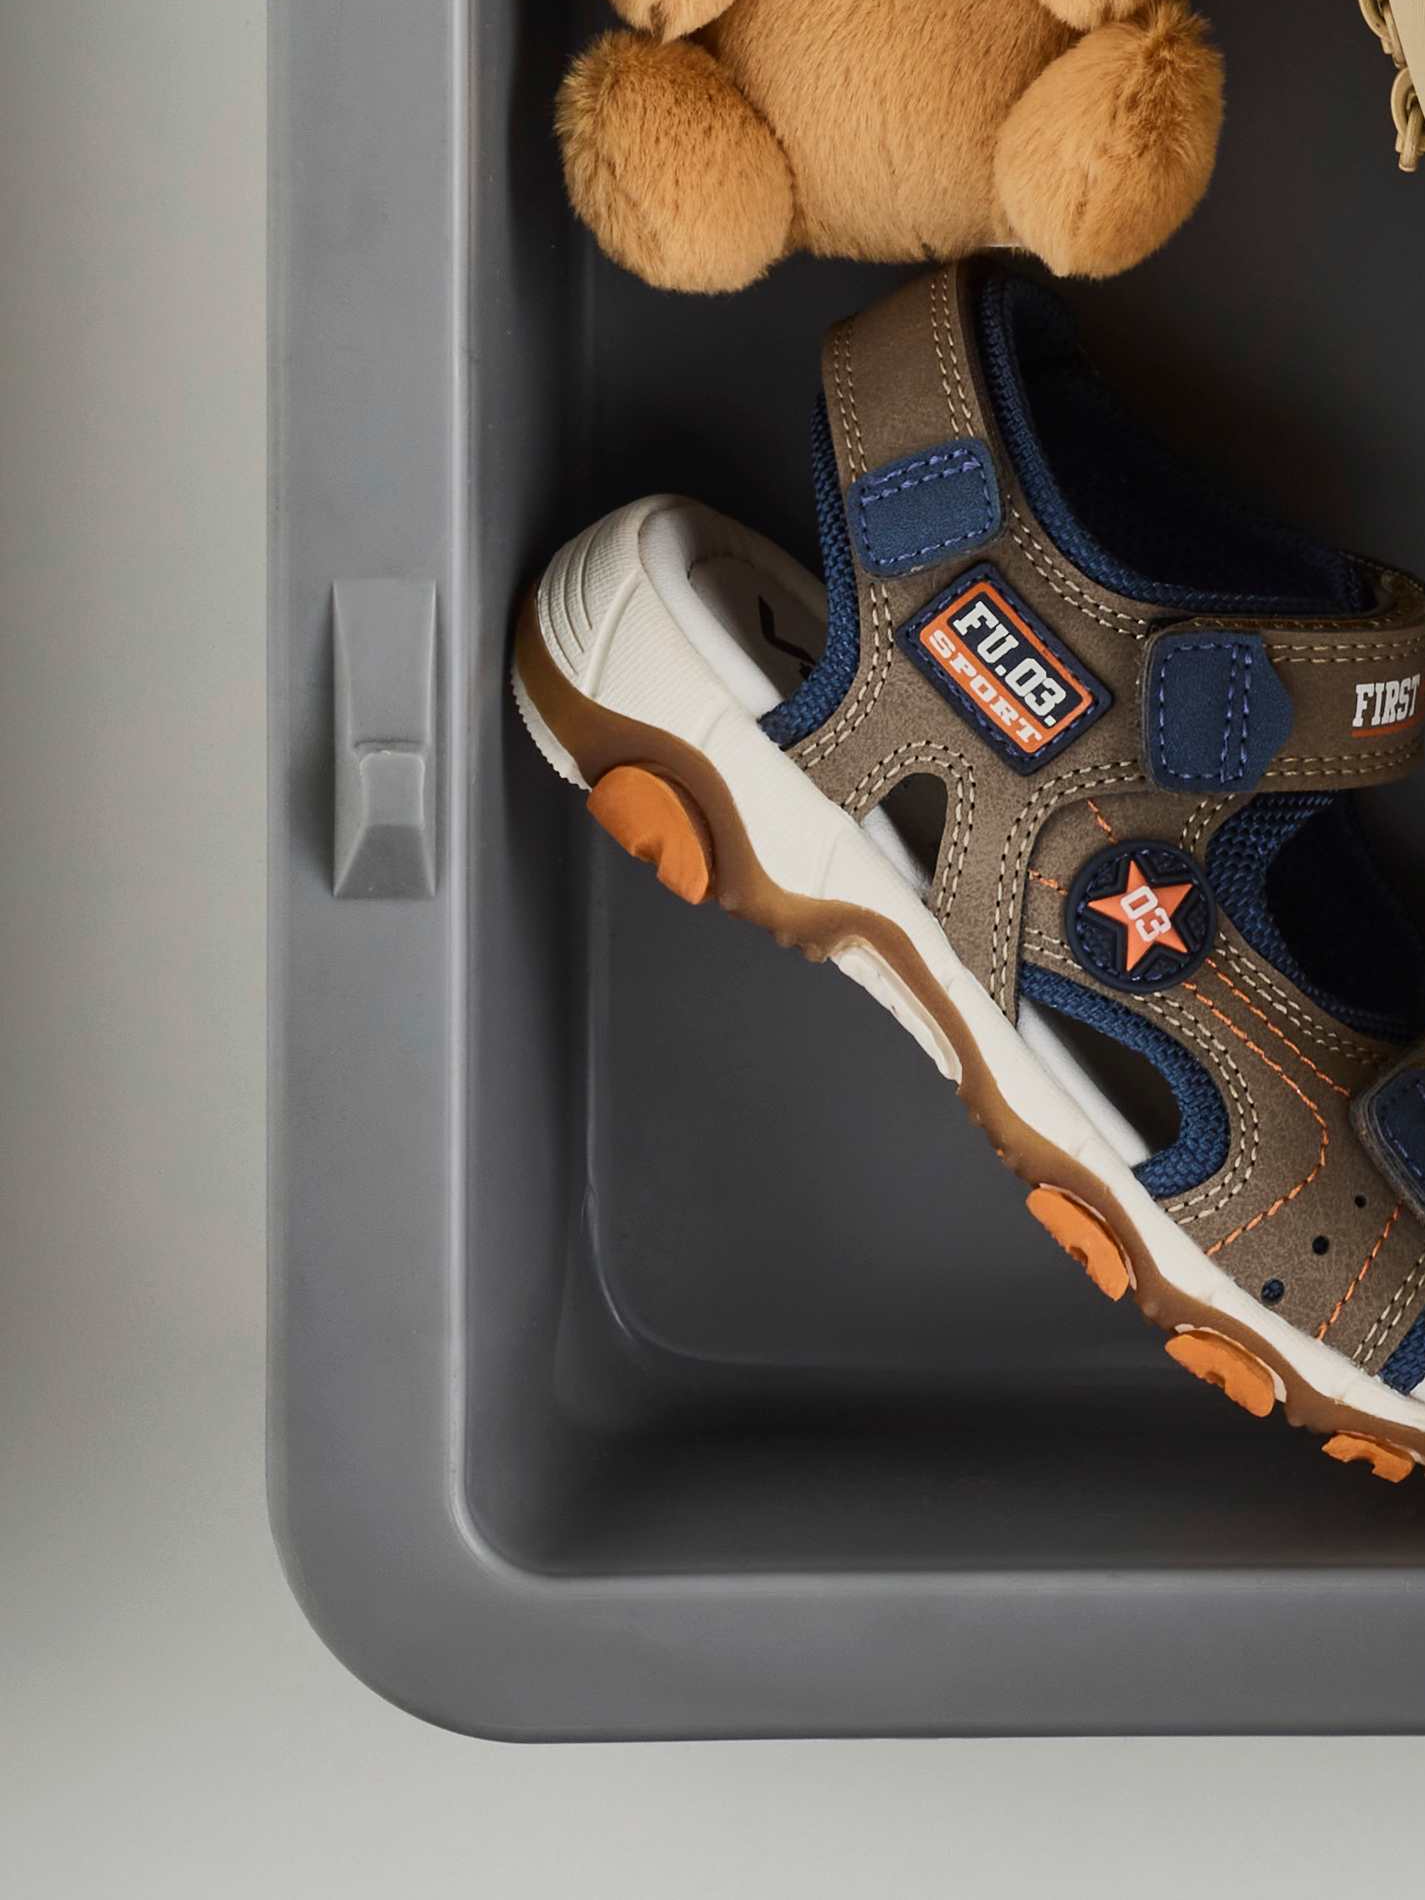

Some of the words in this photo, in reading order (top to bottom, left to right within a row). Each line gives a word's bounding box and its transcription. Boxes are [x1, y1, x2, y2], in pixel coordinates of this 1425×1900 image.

[928, 629, 1043, 743] SPORT
[1352, 673, 1421, 727] FIRST
[1120, 885, 1172, 942] 03
